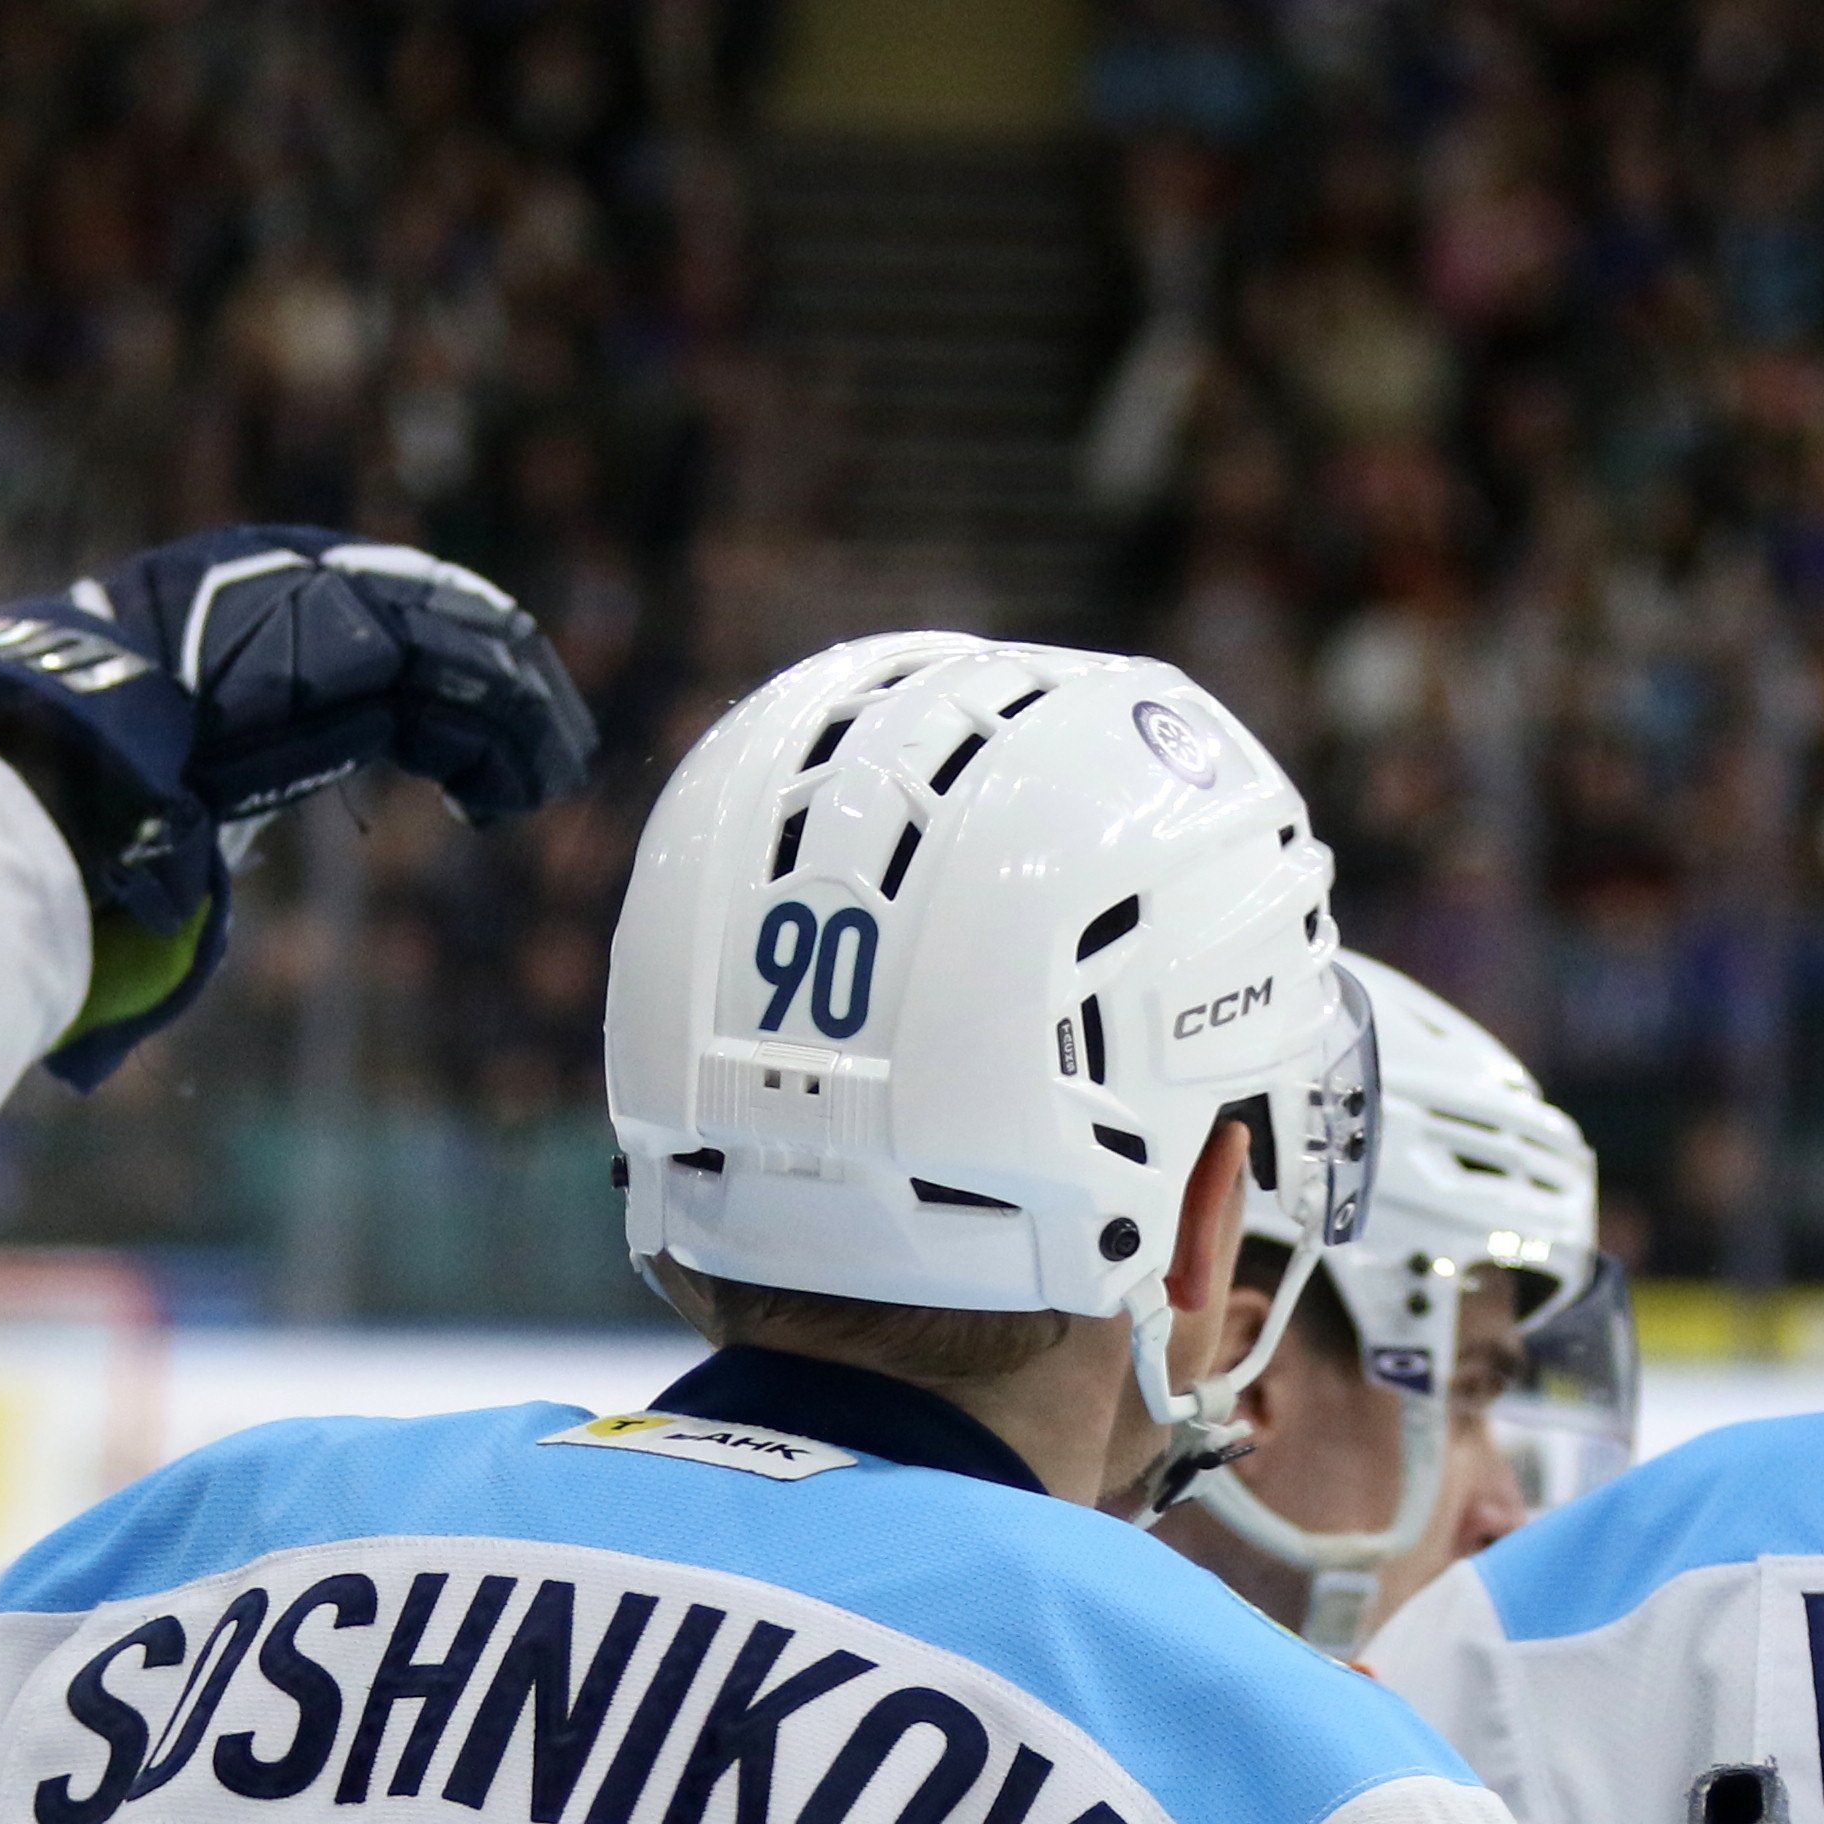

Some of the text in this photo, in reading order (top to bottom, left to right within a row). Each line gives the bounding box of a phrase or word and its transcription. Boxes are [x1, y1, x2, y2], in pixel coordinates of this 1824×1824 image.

[755, 901, 879, 1039] 90
[1173, 974, 1274, 1039] CCM
[662, 1431, 812, 1462] АНК
